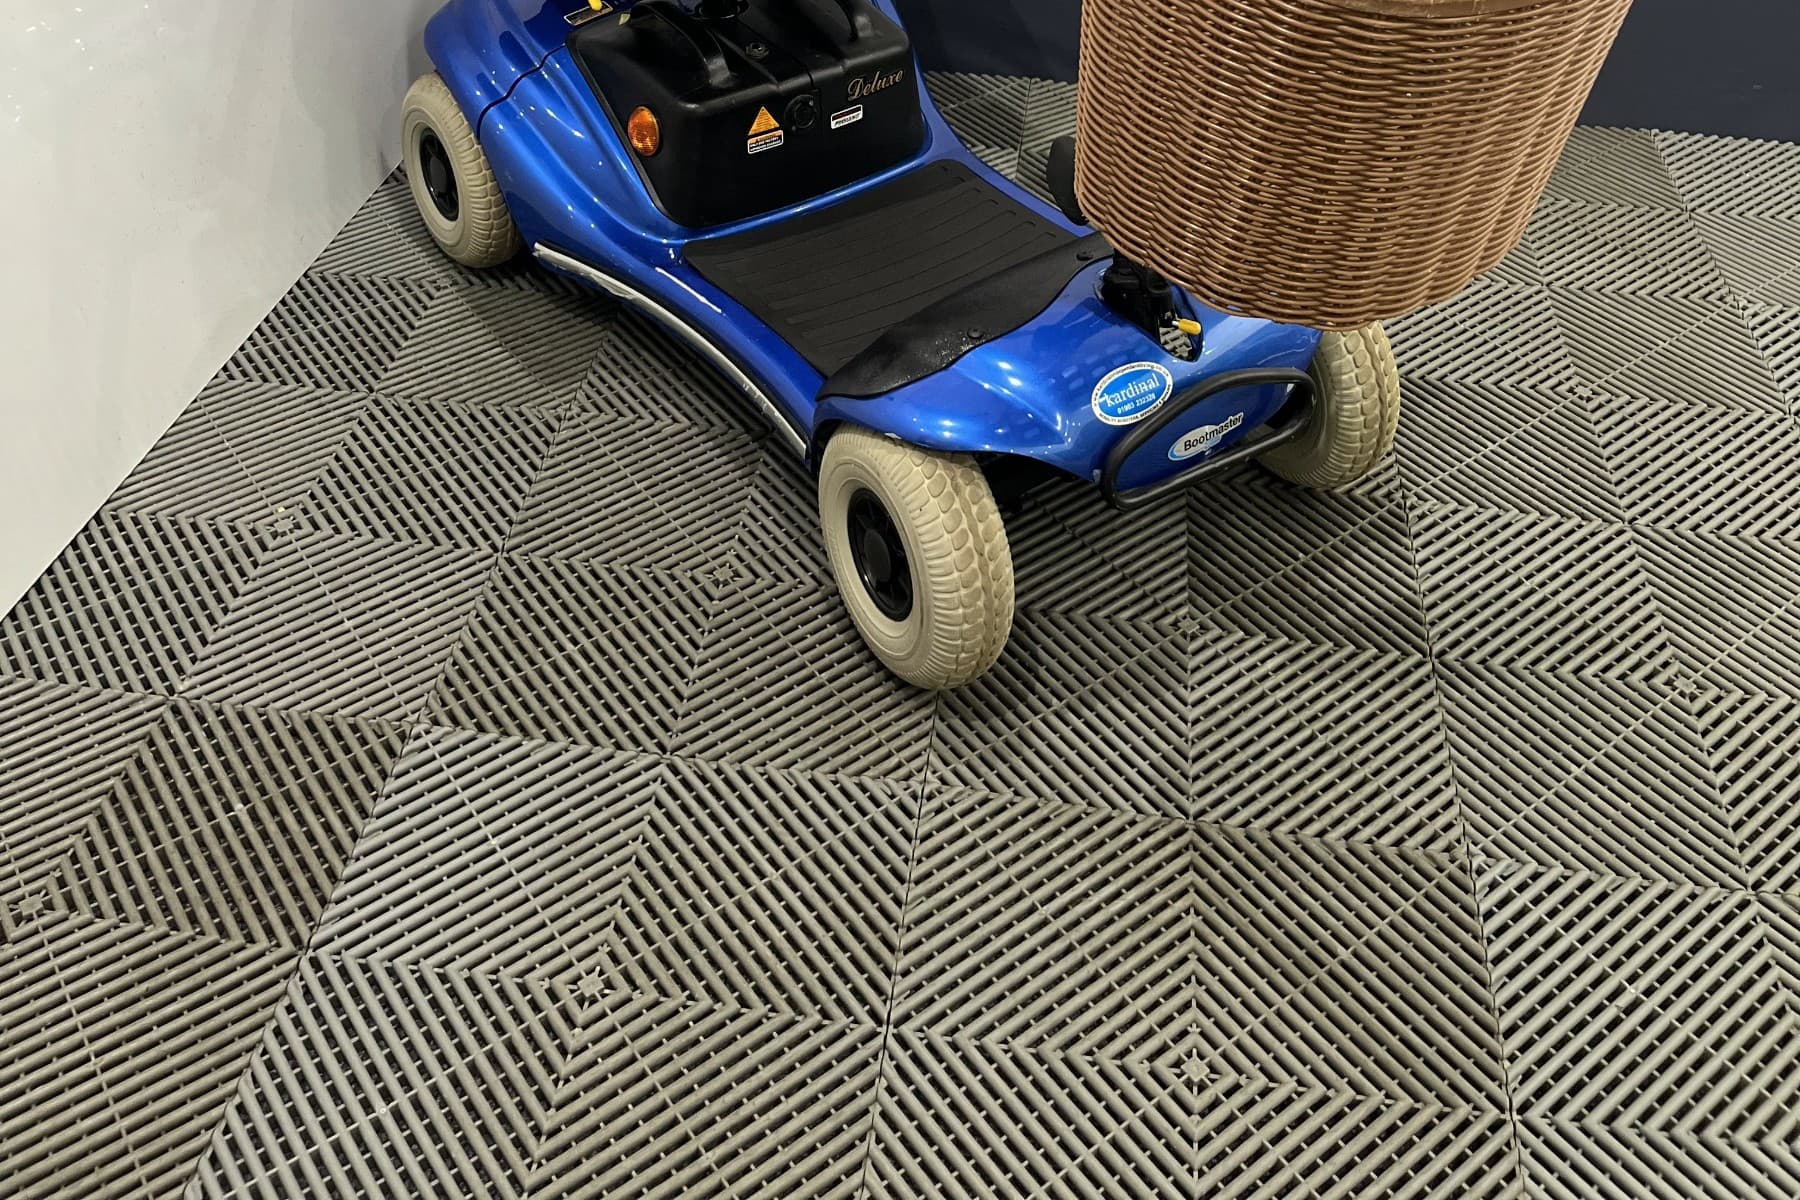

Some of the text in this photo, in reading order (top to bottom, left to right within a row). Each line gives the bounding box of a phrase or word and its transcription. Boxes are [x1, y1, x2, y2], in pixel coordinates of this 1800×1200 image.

[847, 70, 903, 101] Deluxe
[1103, 372, 1159, 407] kardinal
[1183, 414, 1243, 452] Bootmaster
